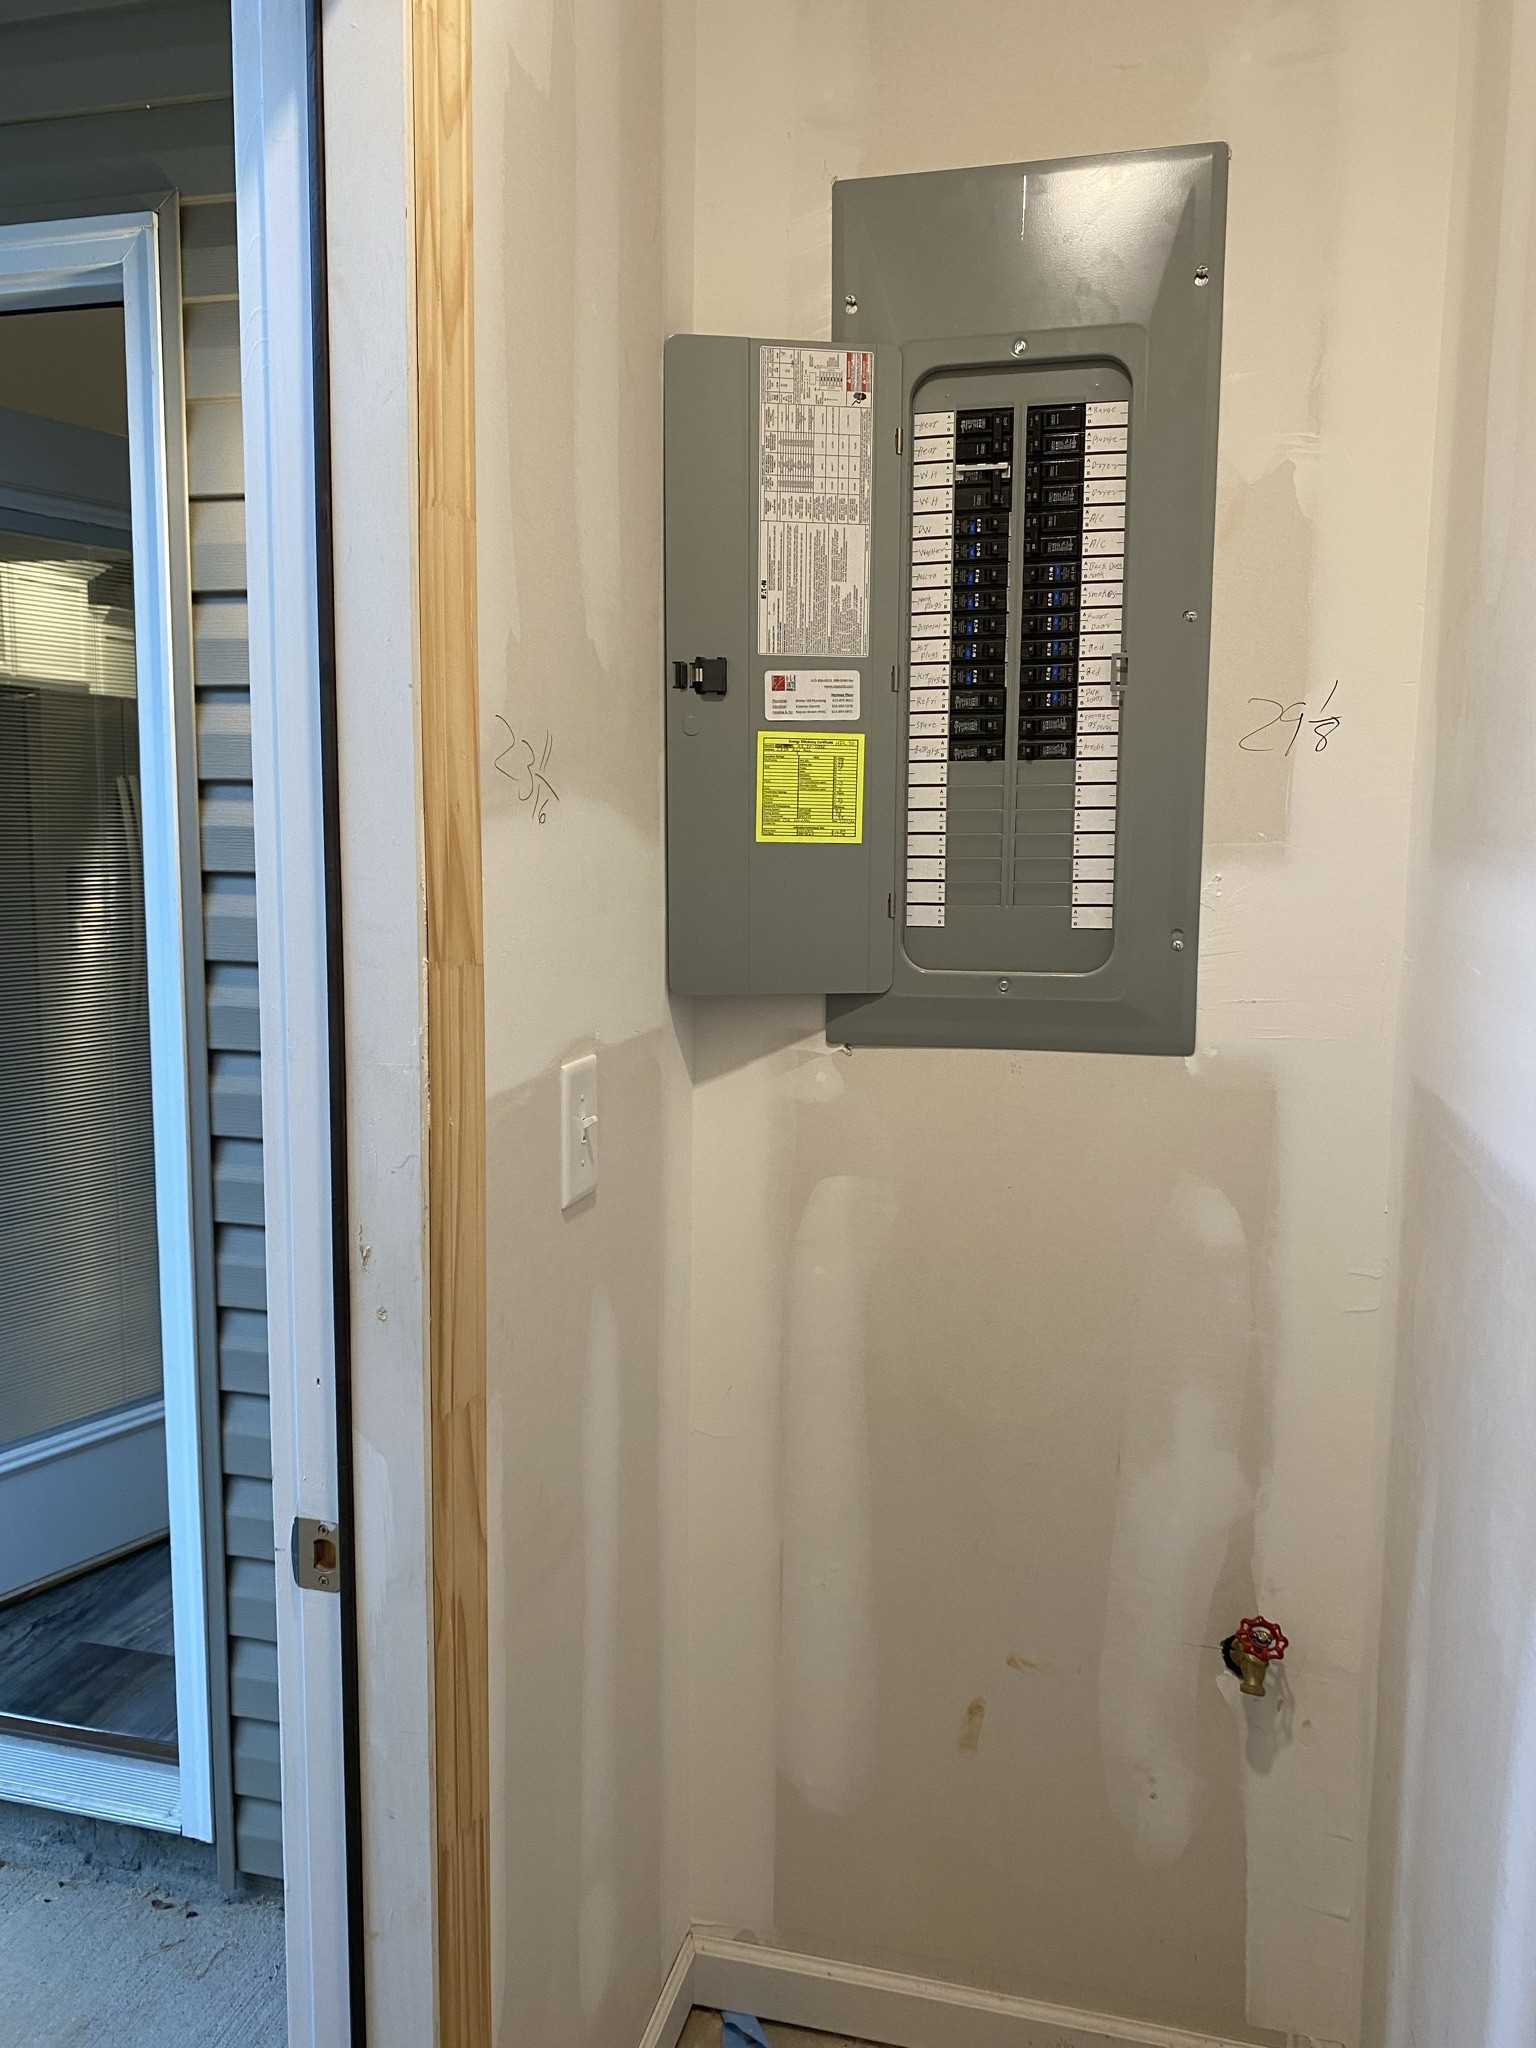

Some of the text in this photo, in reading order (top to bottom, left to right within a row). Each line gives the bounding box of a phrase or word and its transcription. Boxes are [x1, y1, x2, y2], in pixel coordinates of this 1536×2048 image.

[1090, 514, 1104, 523] A/C
[1089, 539, 1105, 548] A/C
[1239, 698, 1306, 756] 29
